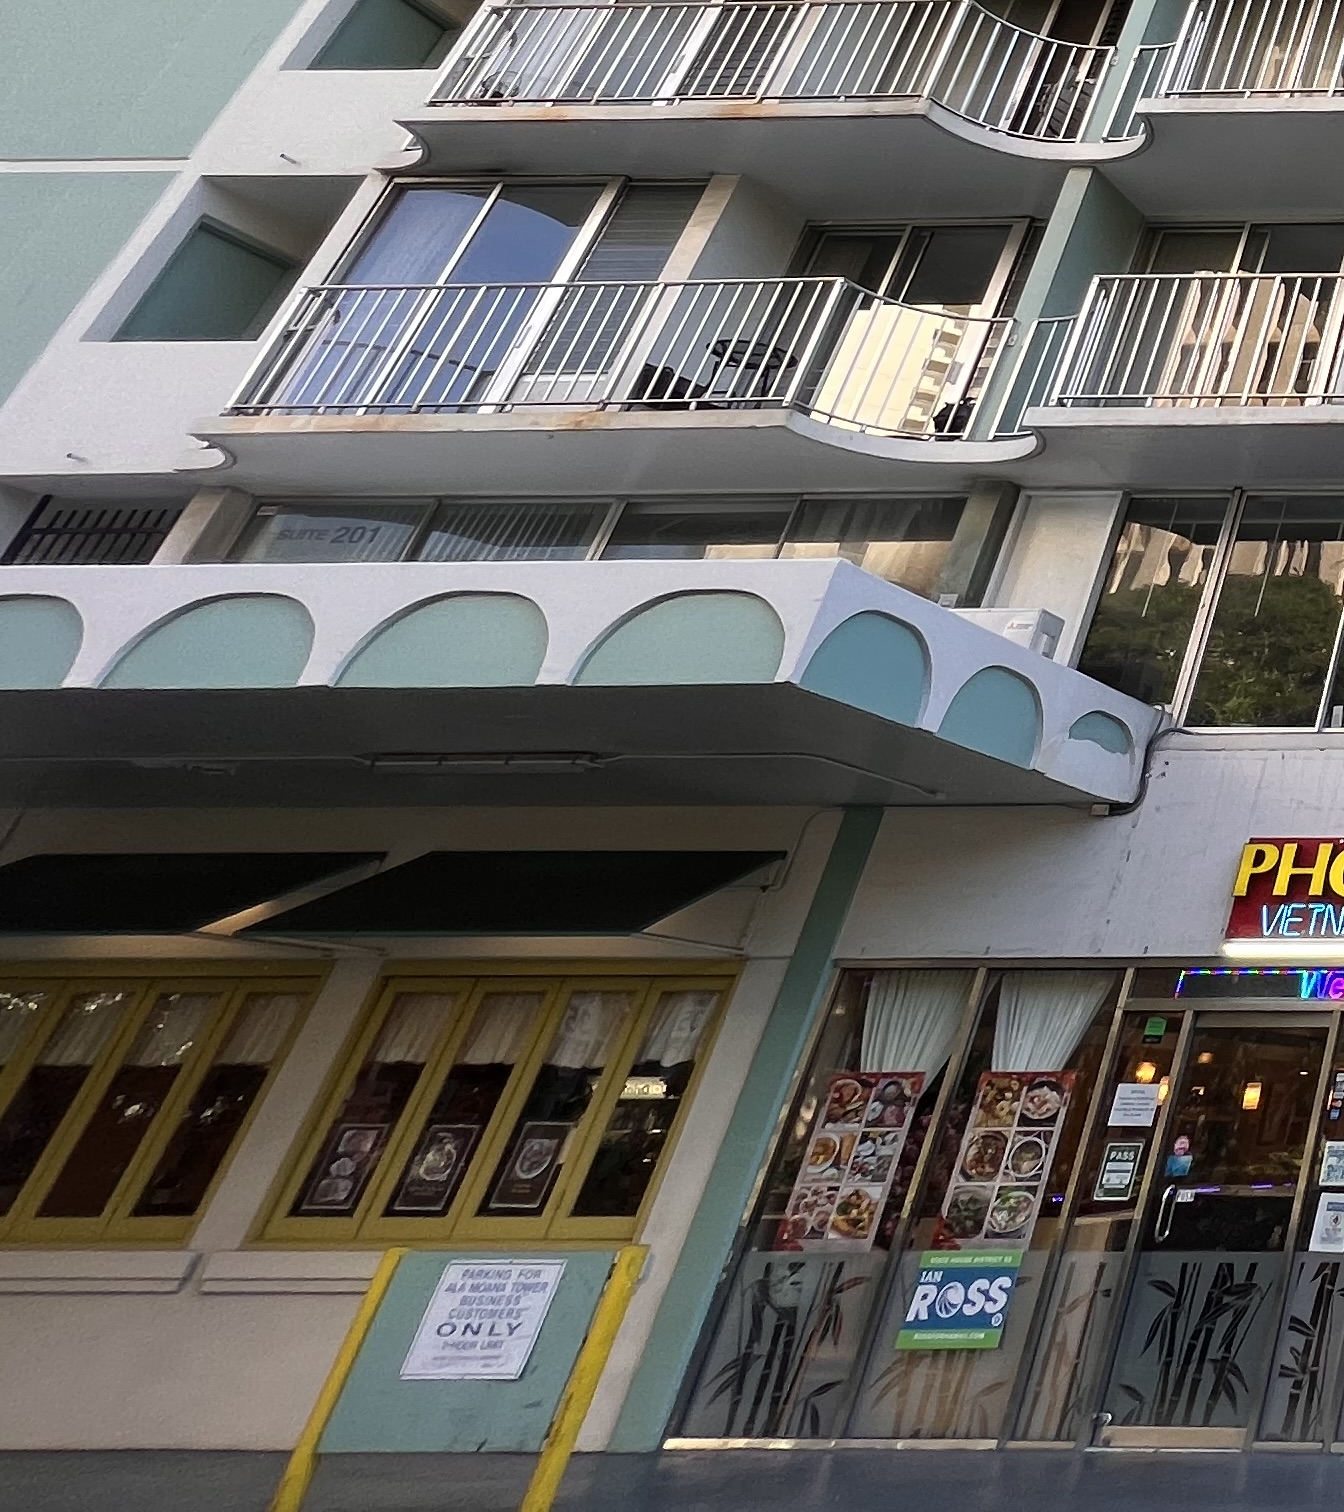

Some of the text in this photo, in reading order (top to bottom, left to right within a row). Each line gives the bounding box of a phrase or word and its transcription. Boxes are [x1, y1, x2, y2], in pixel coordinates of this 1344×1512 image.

[276, 526, 384, 544] SUITE 201
[1109, 1151, 1136, 1161] PASS
[461, 1269, 543, 1280] PARKING FOR
[920, 1270, 943, 1283] IAN
[510, 1281, 549, 1294] TOWER
[459, 1295, 522, 1306] BUSINESS
[905, 1276, 1012, 1322] ROSS
[448, 1308, 522, 1320] CUSTOMERS
[436, 1321, 523, 1337] ONLY
